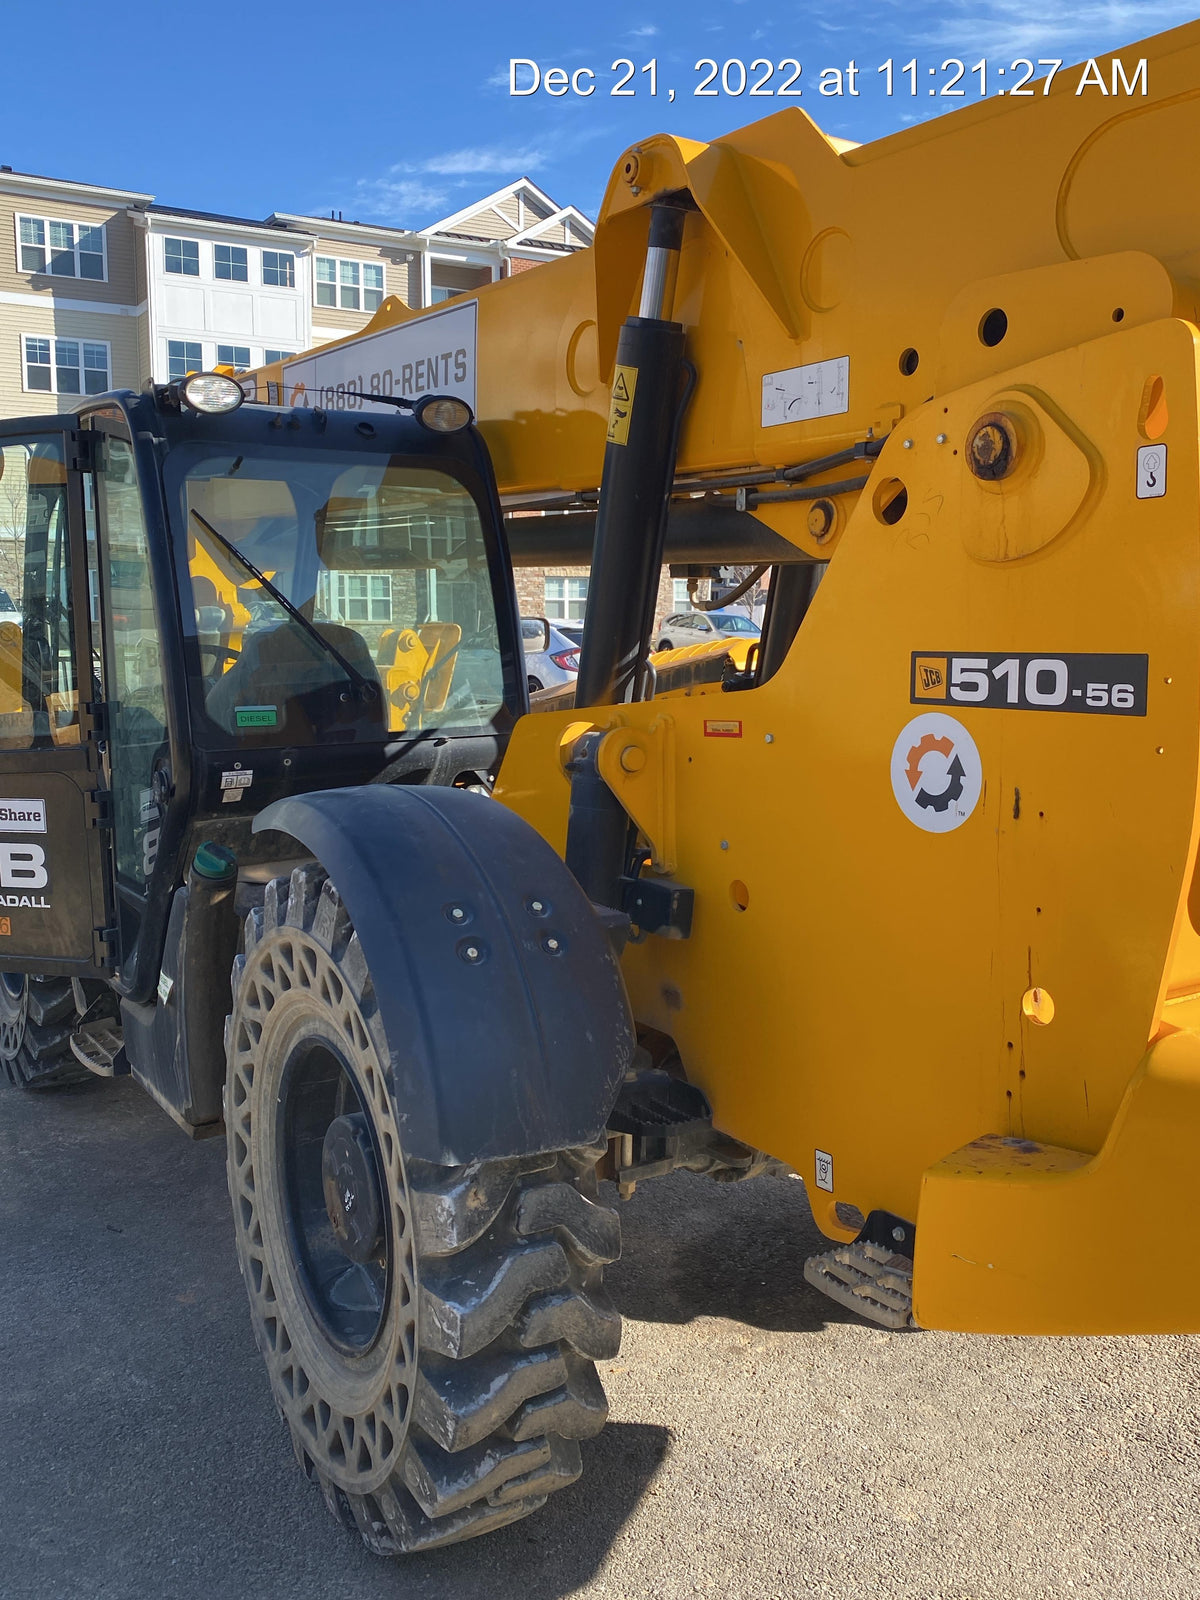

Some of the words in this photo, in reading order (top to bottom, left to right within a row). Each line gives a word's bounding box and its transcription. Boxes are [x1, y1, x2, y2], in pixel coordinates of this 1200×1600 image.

[370, 348, 467, 404] 80-RENTS
[923, 668, 942, 688] JCB
[950, 657, 1136, 708] 510-56
[240, 714, 274, 723] DIESEL
